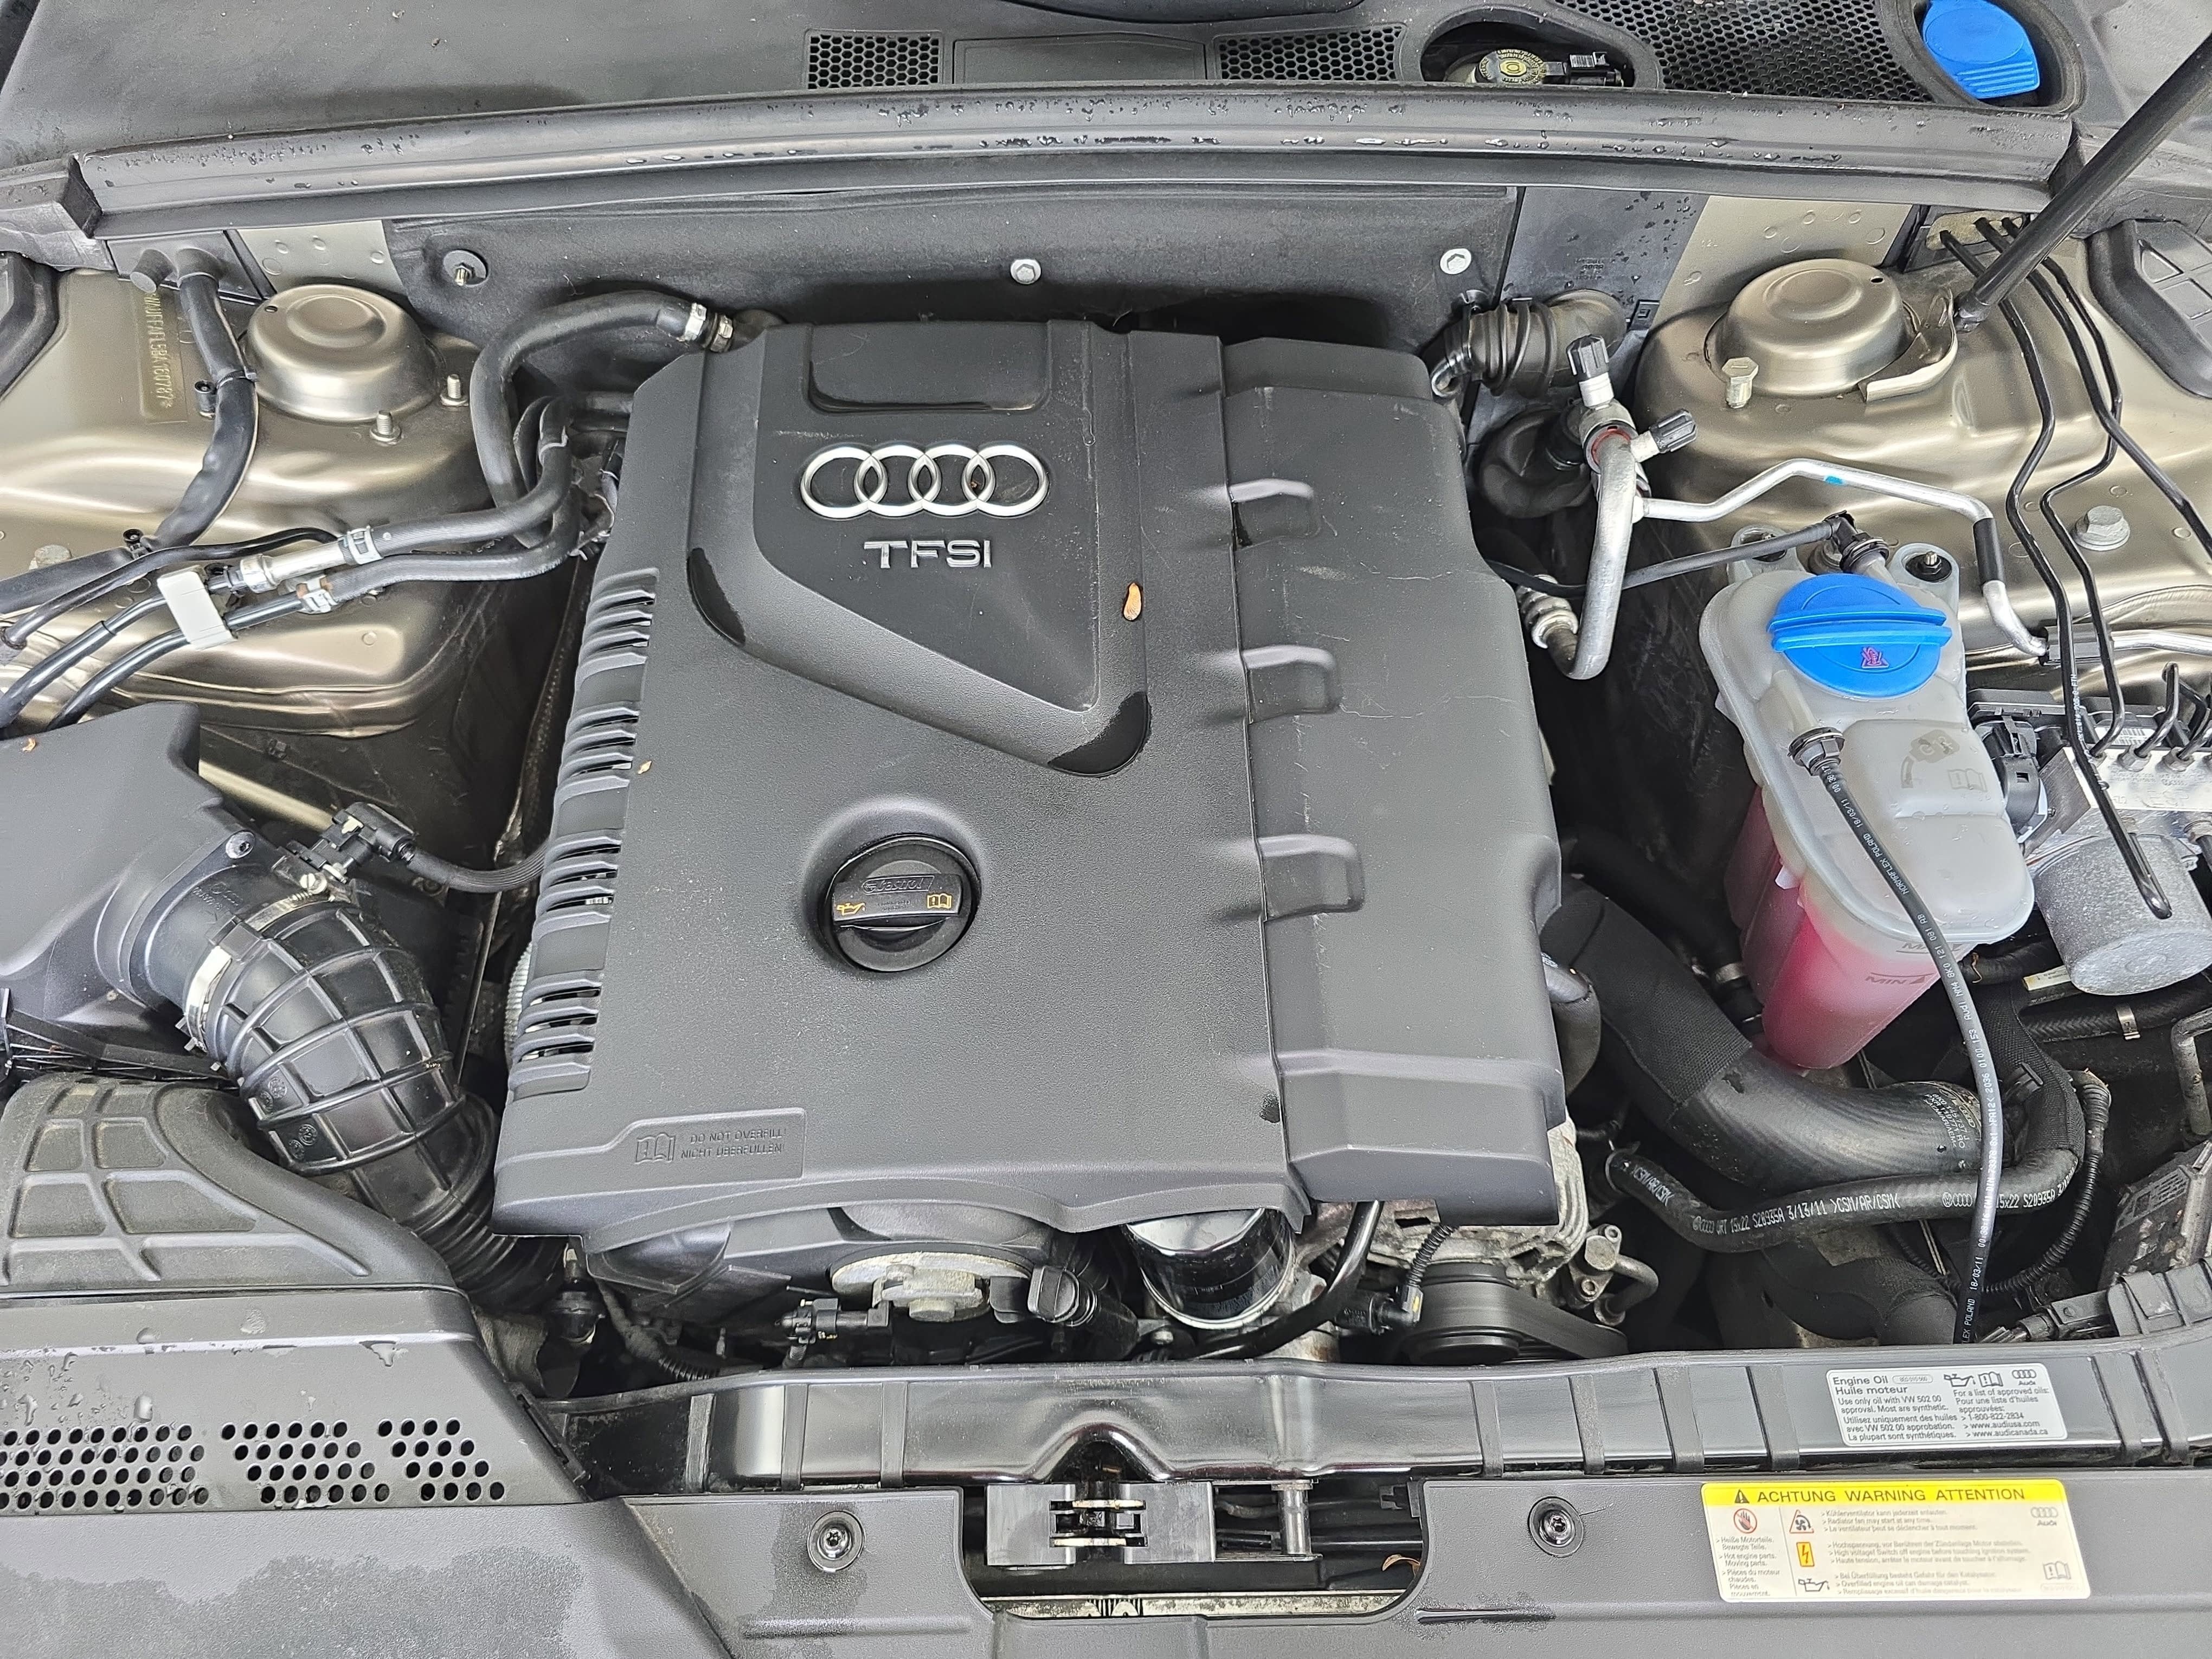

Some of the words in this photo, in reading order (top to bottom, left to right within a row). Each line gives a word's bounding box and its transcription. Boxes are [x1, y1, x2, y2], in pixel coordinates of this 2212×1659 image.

[864, 540, 992, 569] TFSI
[1863, 833, 1882, 857] POLAND
[1880, 857, 1909, 895] NORMAFLEX
[1917, 914, 1928, 924] AB
[1925, 928, 1937, 941] 081
[1934, 946, 1946, 959] 121
[1943, 963, 1955, 978] 8K0
[1866, 976, 1907, 985] MIN
[1950, 981, 1964, 997] NM4
[1969, 1029, 1980, 1044] 153
[1975, 1049, 1987, 1068] 0100
[1982, 1073, 1994, 1093] 2036
[1956, 1118, 1967, 1133] 737
[690, 1134, 705, 1144] DO
[709, 1131, 731, 1142] NOT
[681, 1148, 712, 1159] NICHT
[2023, 1189, 2055, 1208] S20935A
[1731, 1215, 1751, 1233] 15x22
[1787, 1200, 1828, 1221] 3/13/11
[1970, 1257, 1983, 1291] 18/03/11
[1964, 1298, 1975, 1326] POLAND
[1833, 1377, 1870, 1386] Engine
[1874, 1375, 1888, 1384] Oil
[1835, 1386, 1863, 1395] Huile
[1997, 1387, 2032, 1396] approved
[1855, 1397, 1871, 1405] only
[1841, 1406, 1876, 1414] approval.
[1912, 1404, 1949, 1413] synthetic.
[1959, 1405, 2005, 1414] approuvées:
[1843, 1416, 1870, 1424] Utilisez
[1873, 1416, 1918, 1425] uniquement
[1968, 1412, 2024, 1420] 1-800-822-2834
[1907, 1423, 1954, 1432] approbation.
[1859, 1433, 1886, 1442] plupart
[1906, 1431, 1956, 1441] synthétiques.
[1757, 1490, 1836, 1503] ACHTUNG
[1844, 1490, 1926, 1502] WARNING
[1936, 1488, 2025, 1501] ATTENTION
